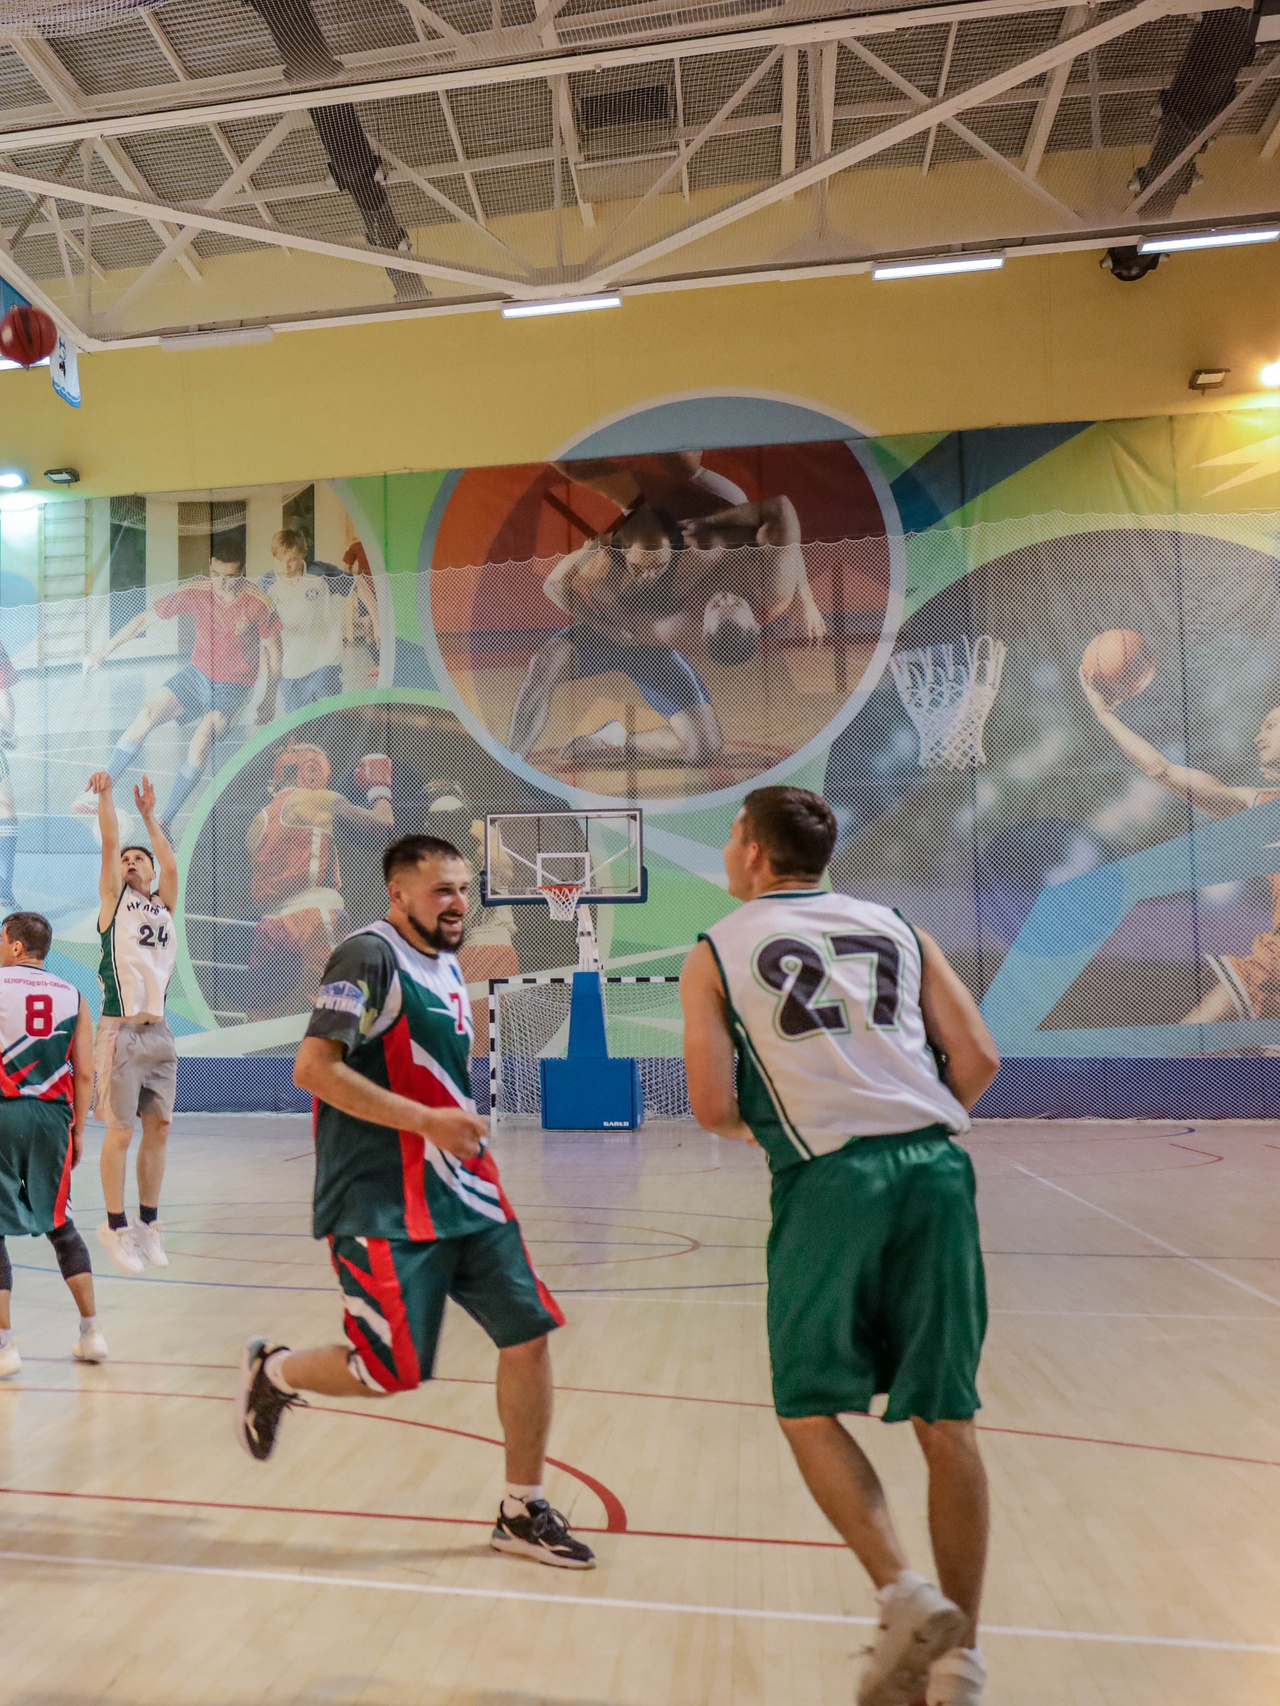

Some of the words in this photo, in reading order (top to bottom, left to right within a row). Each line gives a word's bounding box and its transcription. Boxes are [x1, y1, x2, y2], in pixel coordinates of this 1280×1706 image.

[139, 924, 168, 947] 24
[754, 931, 902, 1038] 27
[25, 994, 53, 1037] 8
[448, 992, 465, 1031] 7
